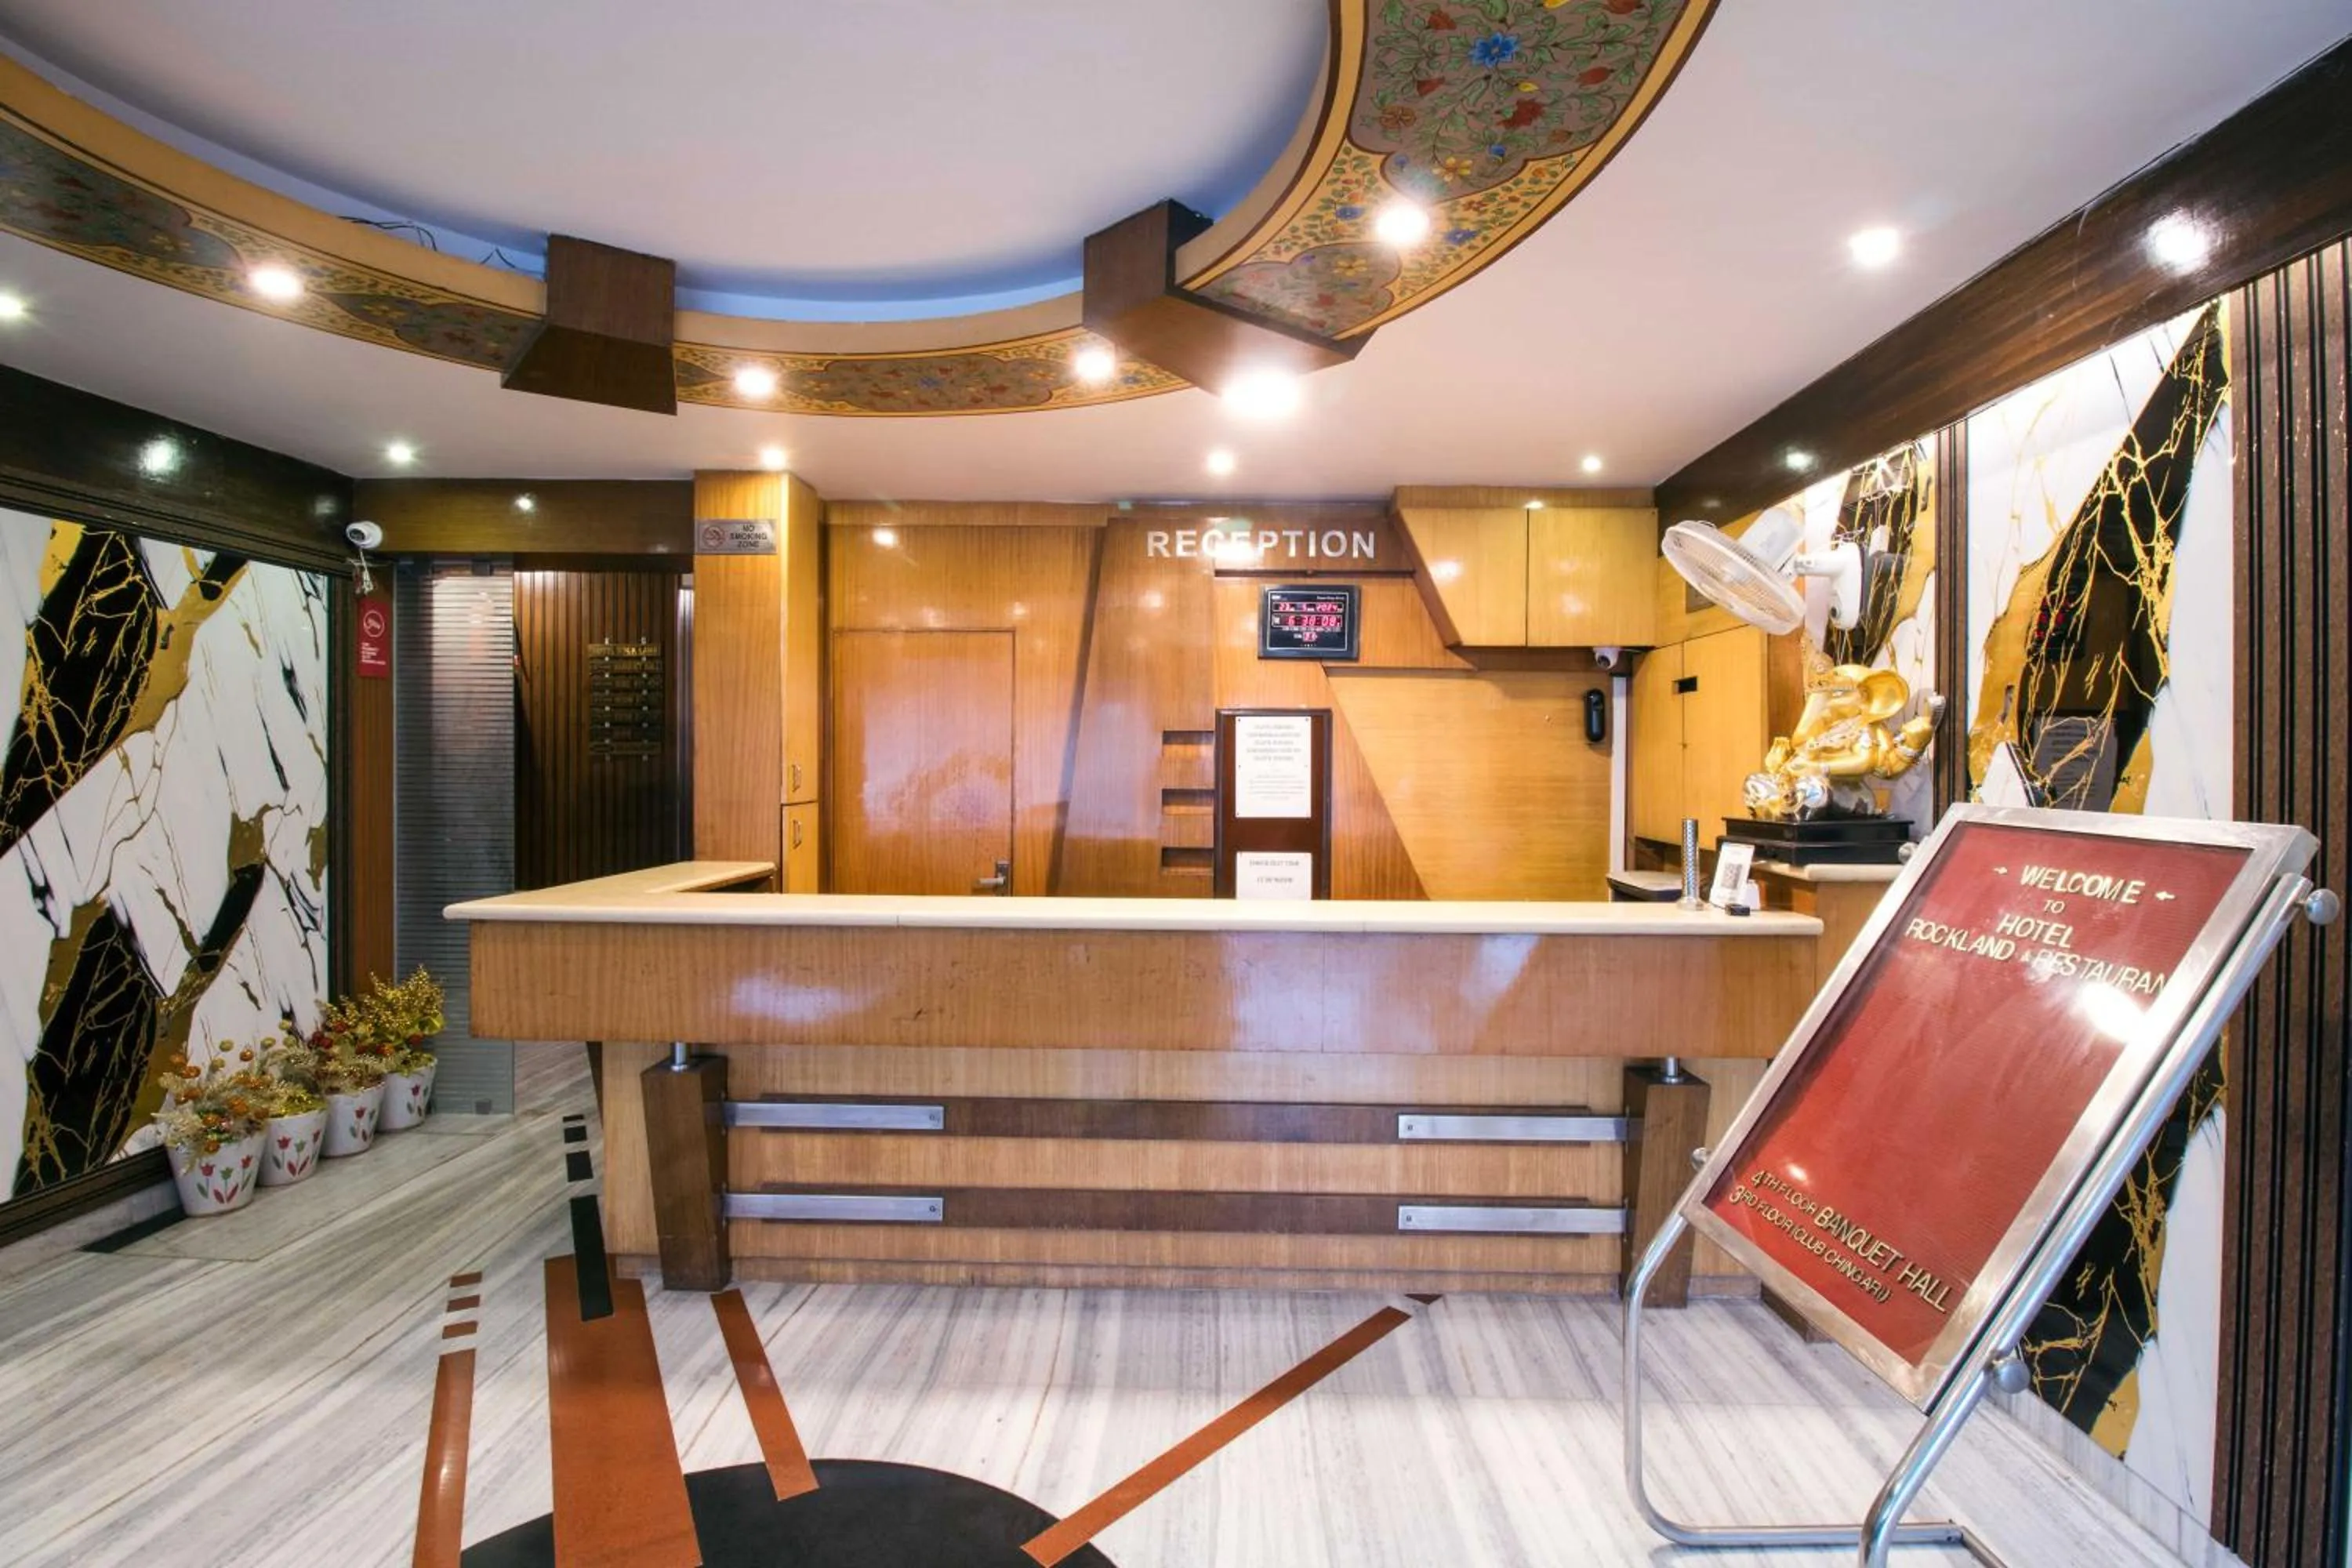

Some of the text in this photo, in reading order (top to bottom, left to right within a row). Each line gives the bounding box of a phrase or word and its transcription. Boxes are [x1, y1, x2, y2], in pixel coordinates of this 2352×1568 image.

[1147, 530, 1374, 558] RECEPTION
[2020, 865, 2146, 904] WELCOME
[2044, 899, 2065, 913] TO
[1905, 918, 2016, 961] ROCKLAND
[1997, 913, 2074, 949] HOTEL
[1729, 1185, 1759, 1207] 3RD
[1756, 1201, 1793, 1232] FLOOR
[1751, 1171, 1953, 1314] 4TH FLOOR BANQUET HALL
